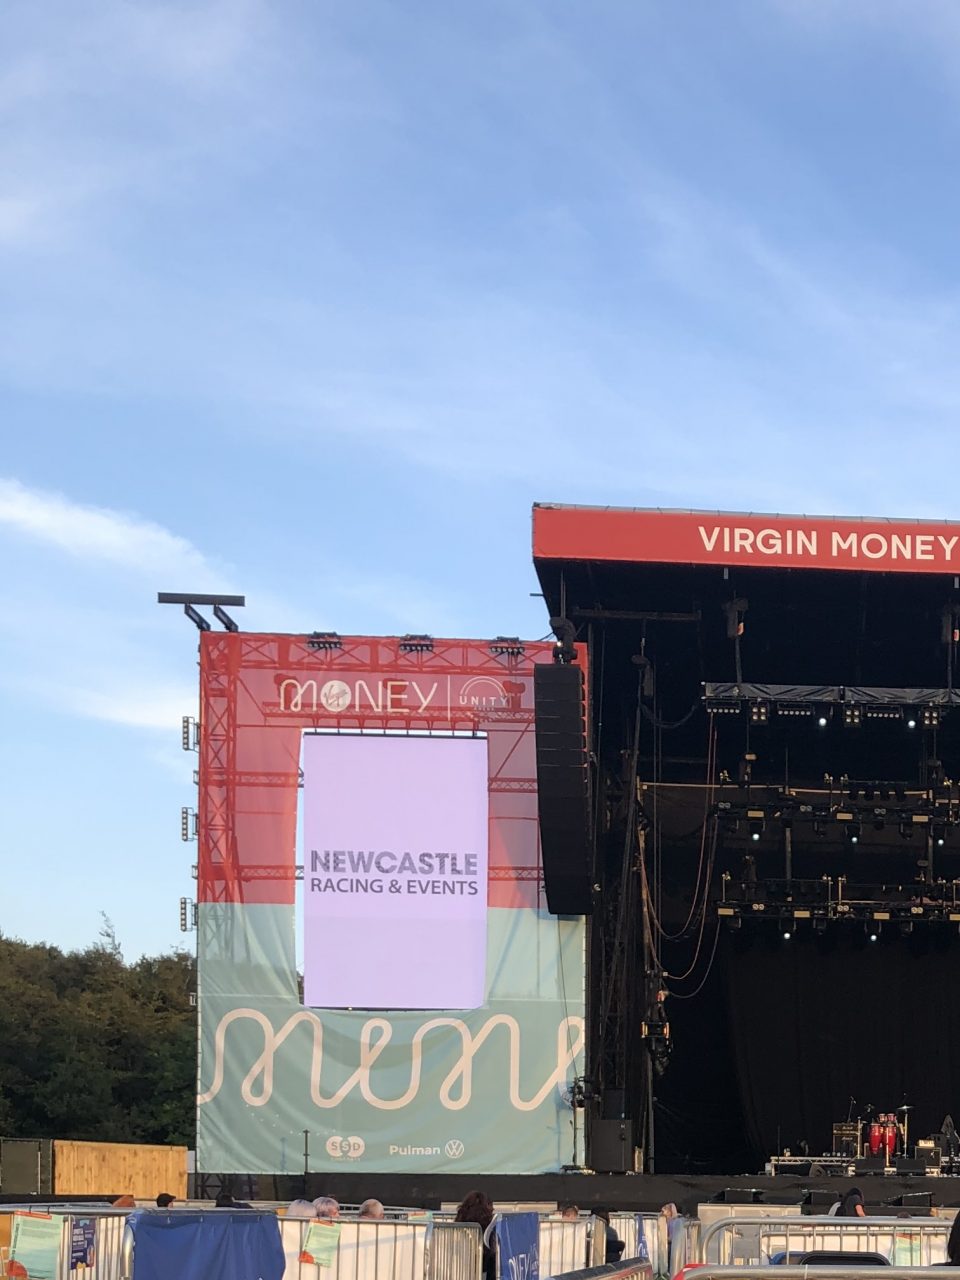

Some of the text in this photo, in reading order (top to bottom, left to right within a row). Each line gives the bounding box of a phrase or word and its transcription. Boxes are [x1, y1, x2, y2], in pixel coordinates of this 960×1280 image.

[698, 526, 818, 556] VIRGIN
[831, 531, 959, 561] MONEY
[280, 679, 438, 713] MONEY
[459, 695, 508, 706] UNITY
[311, 849, 478, 876] NEWCASTLE
[311, 877, 479, 896] RACING & EVENTS
[389, 1144, 441, 1156] Pulman
